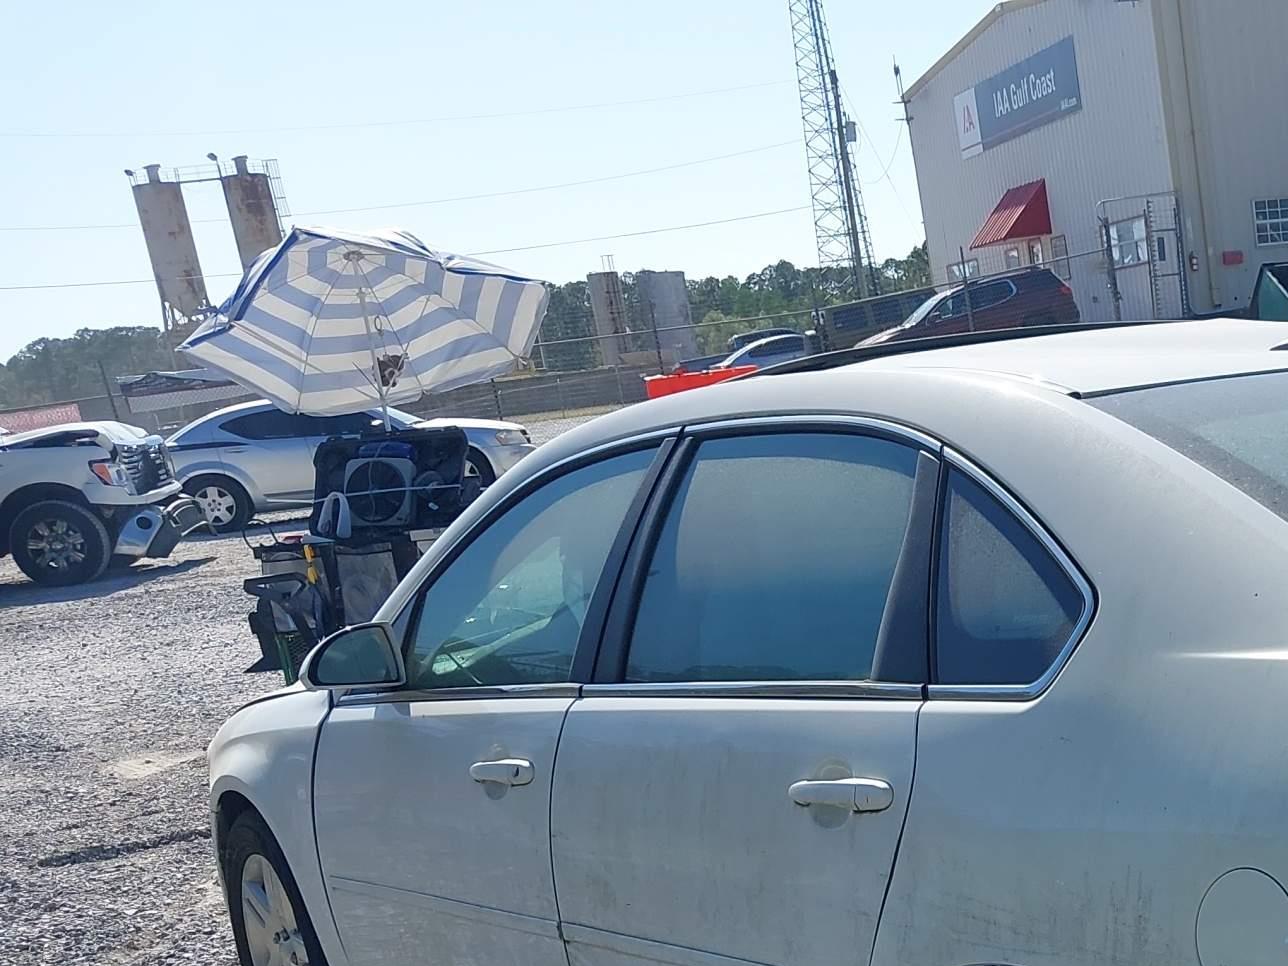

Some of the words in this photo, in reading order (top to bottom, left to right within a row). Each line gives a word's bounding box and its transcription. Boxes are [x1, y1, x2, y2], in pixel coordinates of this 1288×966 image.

[993, 87, 1011, 118] IAA
[1010, 77, 1030, 110] Gulf
[1029, 68, 1056, 101] Coast
